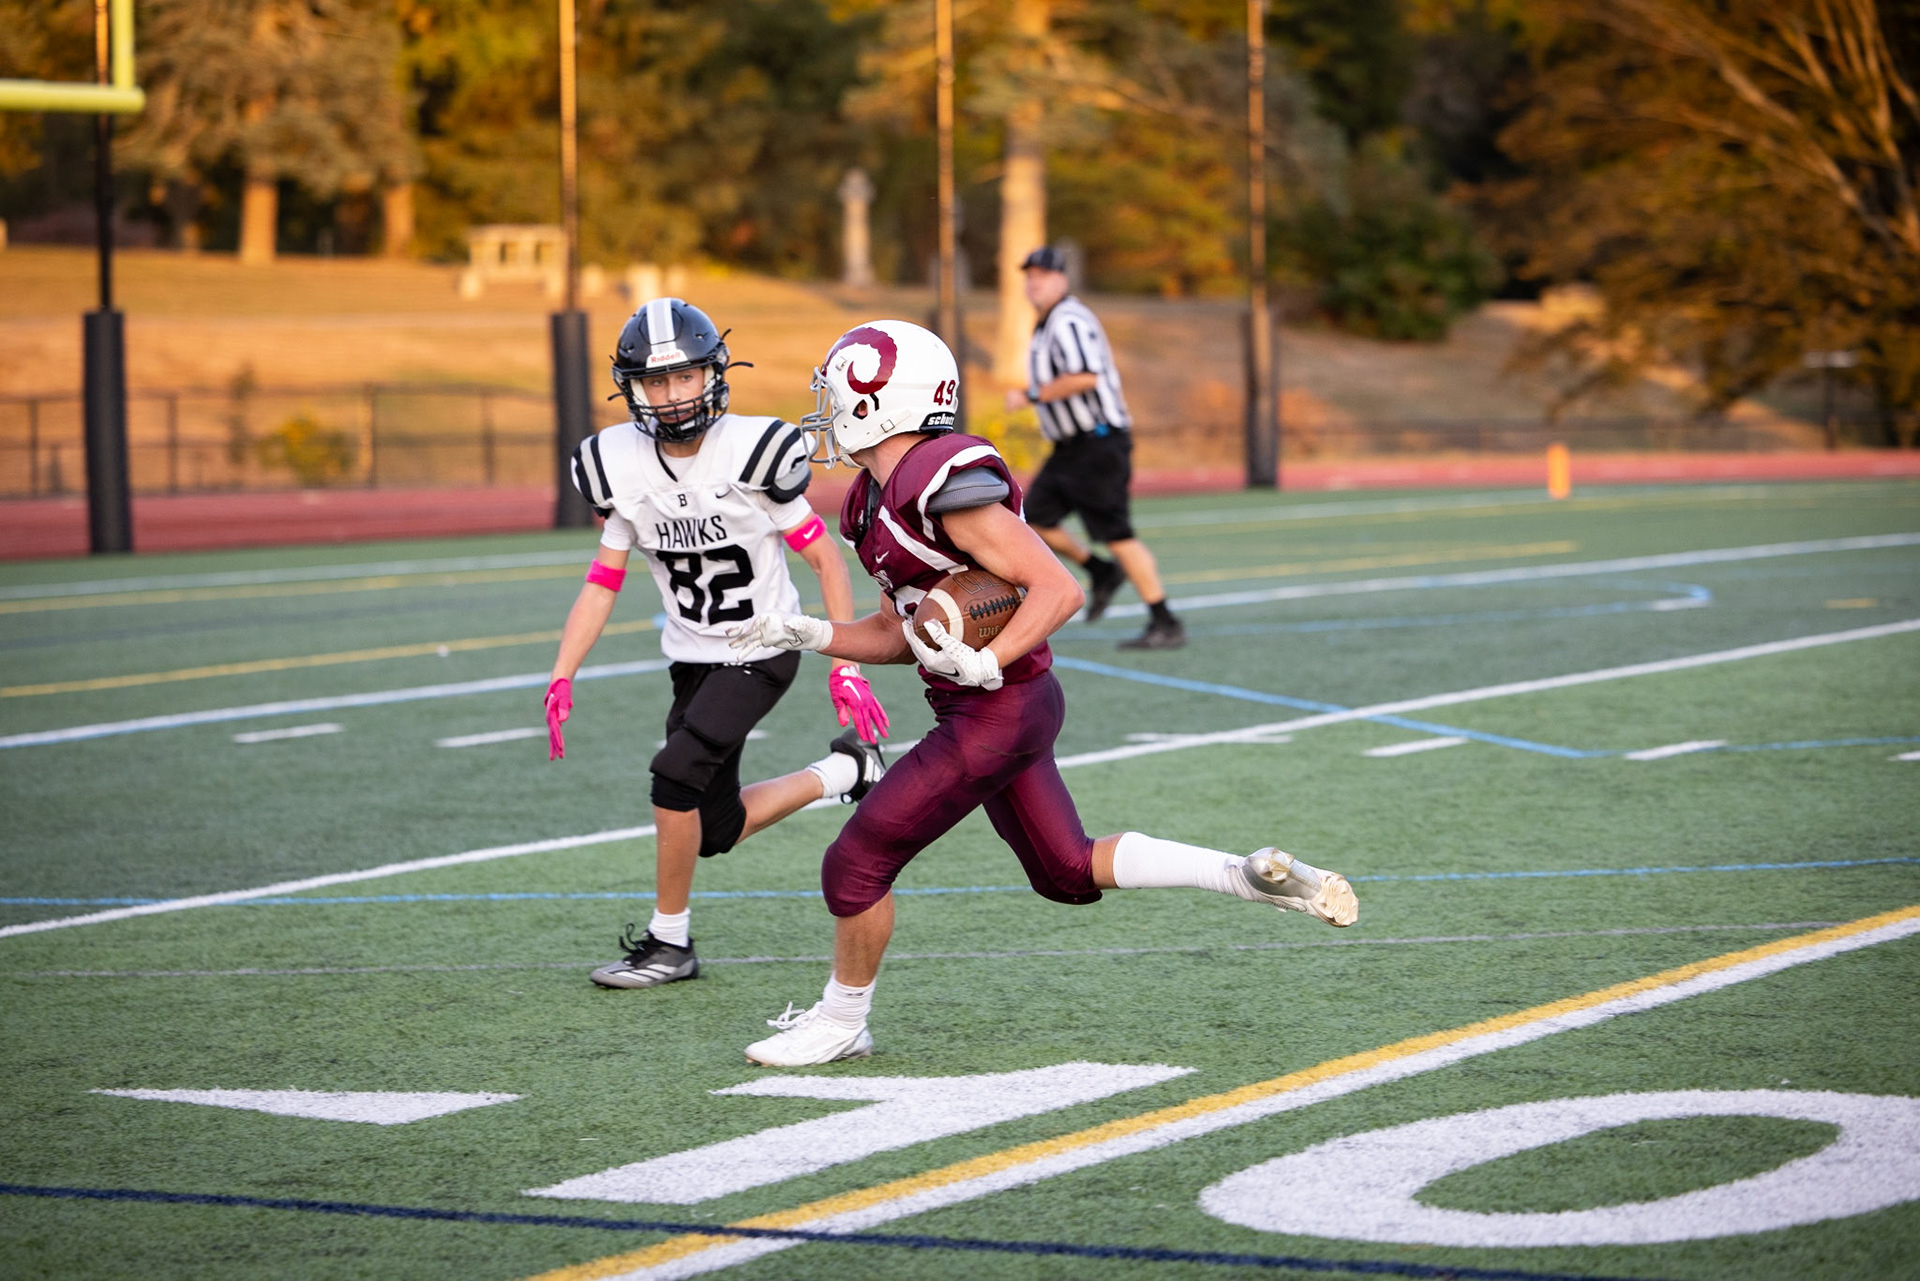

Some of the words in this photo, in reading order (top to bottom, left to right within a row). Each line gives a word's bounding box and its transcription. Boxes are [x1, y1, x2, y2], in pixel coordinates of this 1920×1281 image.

[650, 352, 681, 363] Riddell
[933, 379, 956, 406] 49
[677, 493, 688, 507] B
[655, 515, 727, 549] HAWKS
[655, 544, 755, 626] 82
